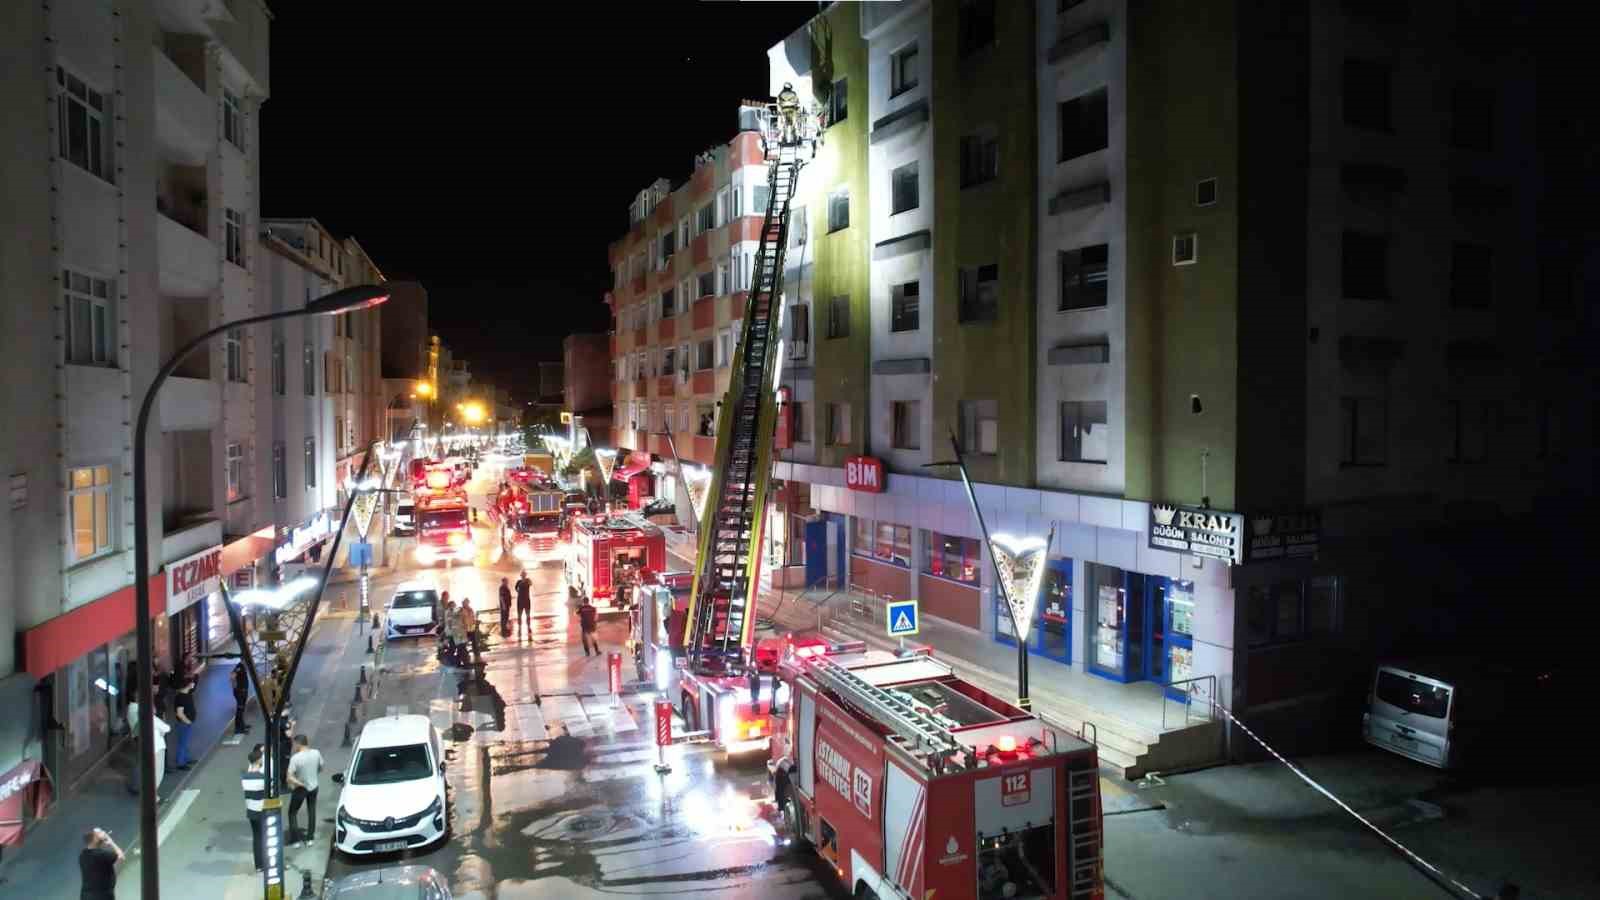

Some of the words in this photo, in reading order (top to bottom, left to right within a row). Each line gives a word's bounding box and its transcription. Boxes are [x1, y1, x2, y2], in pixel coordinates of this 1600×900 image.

[848, 457, 877, 487] BİM
[1179, 511, 1233, 533] KRAL
[1153, 525, 1184, 540] DÜĞÜN
[1191, 532, 1231, 547] SALONU
[856, 773, 870, 799] 112
[1005, 774, 1027, 793] 112
